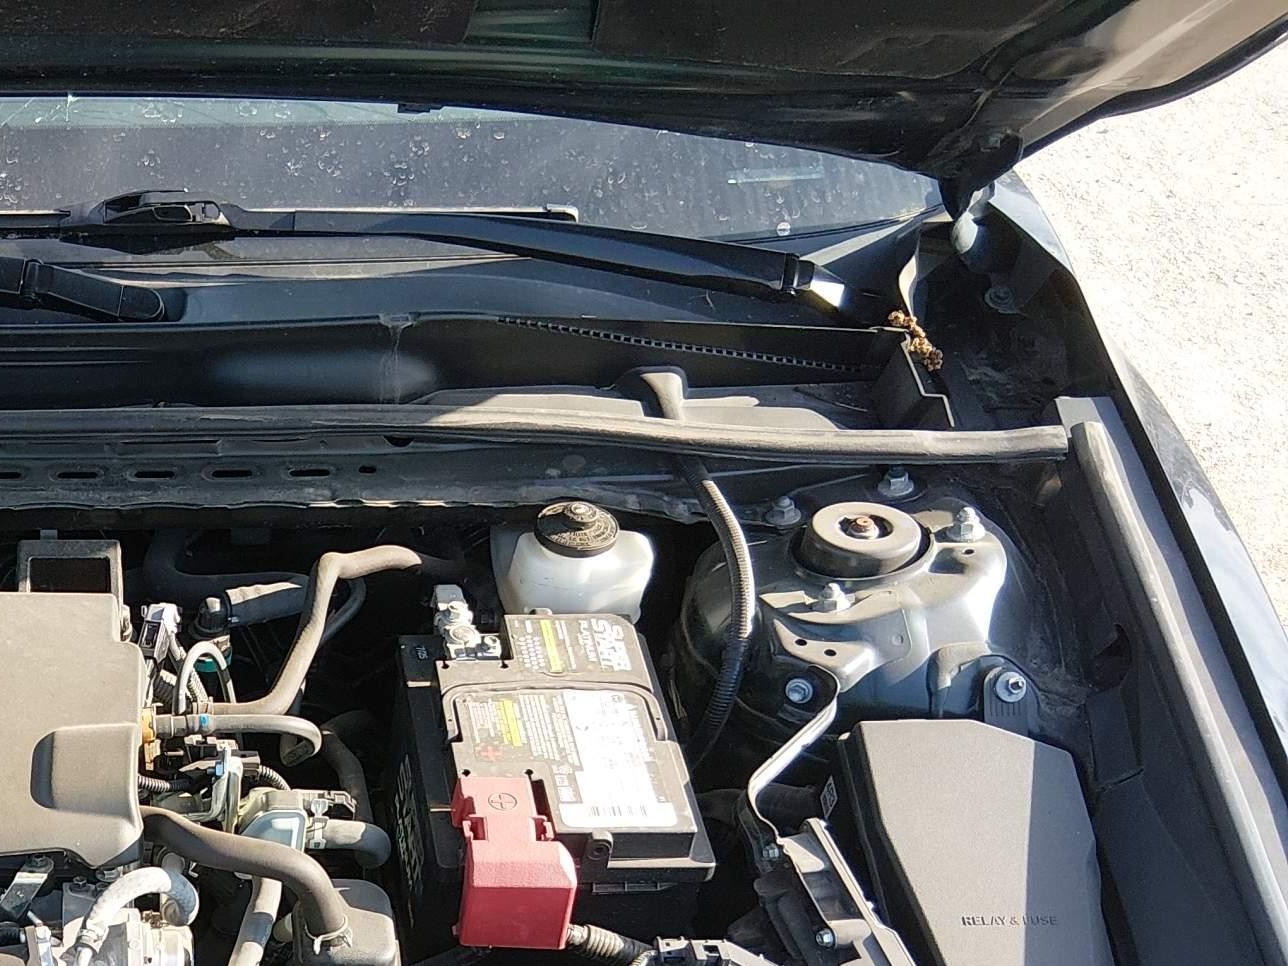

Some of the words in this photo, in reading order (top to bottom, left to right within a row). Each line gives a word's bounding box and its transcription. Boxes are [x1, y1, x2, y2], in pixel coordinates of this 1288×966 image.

[961, 915, 1006, 927] RELAY
[1009, 915, 1019, 926] &
[1022, 915, 1057, 926] FUSE
